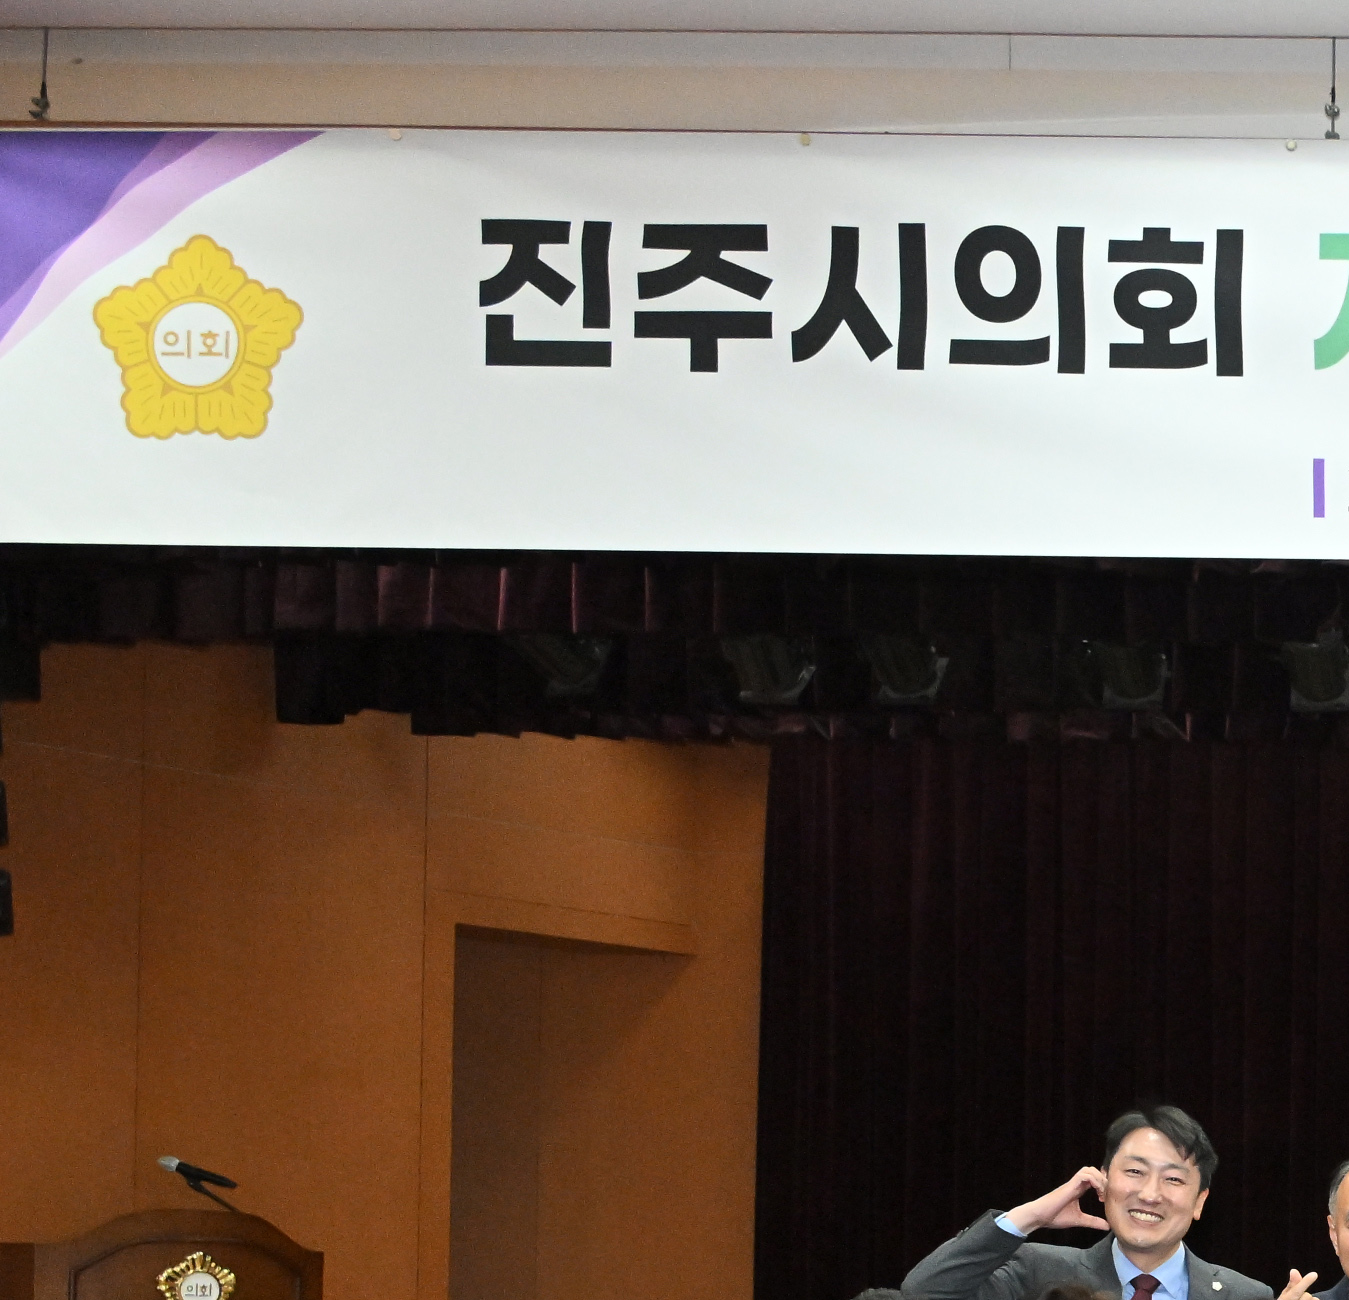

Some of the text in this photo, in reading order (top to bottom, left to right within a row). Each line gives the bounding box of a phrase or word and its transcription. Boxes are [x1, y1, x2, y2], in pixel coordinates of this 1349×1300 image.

[479, 218, 1244, 377] 진주시의회
[161, 329, 230, 359] 의회
[185, 1283, 212, 1297] 의회
